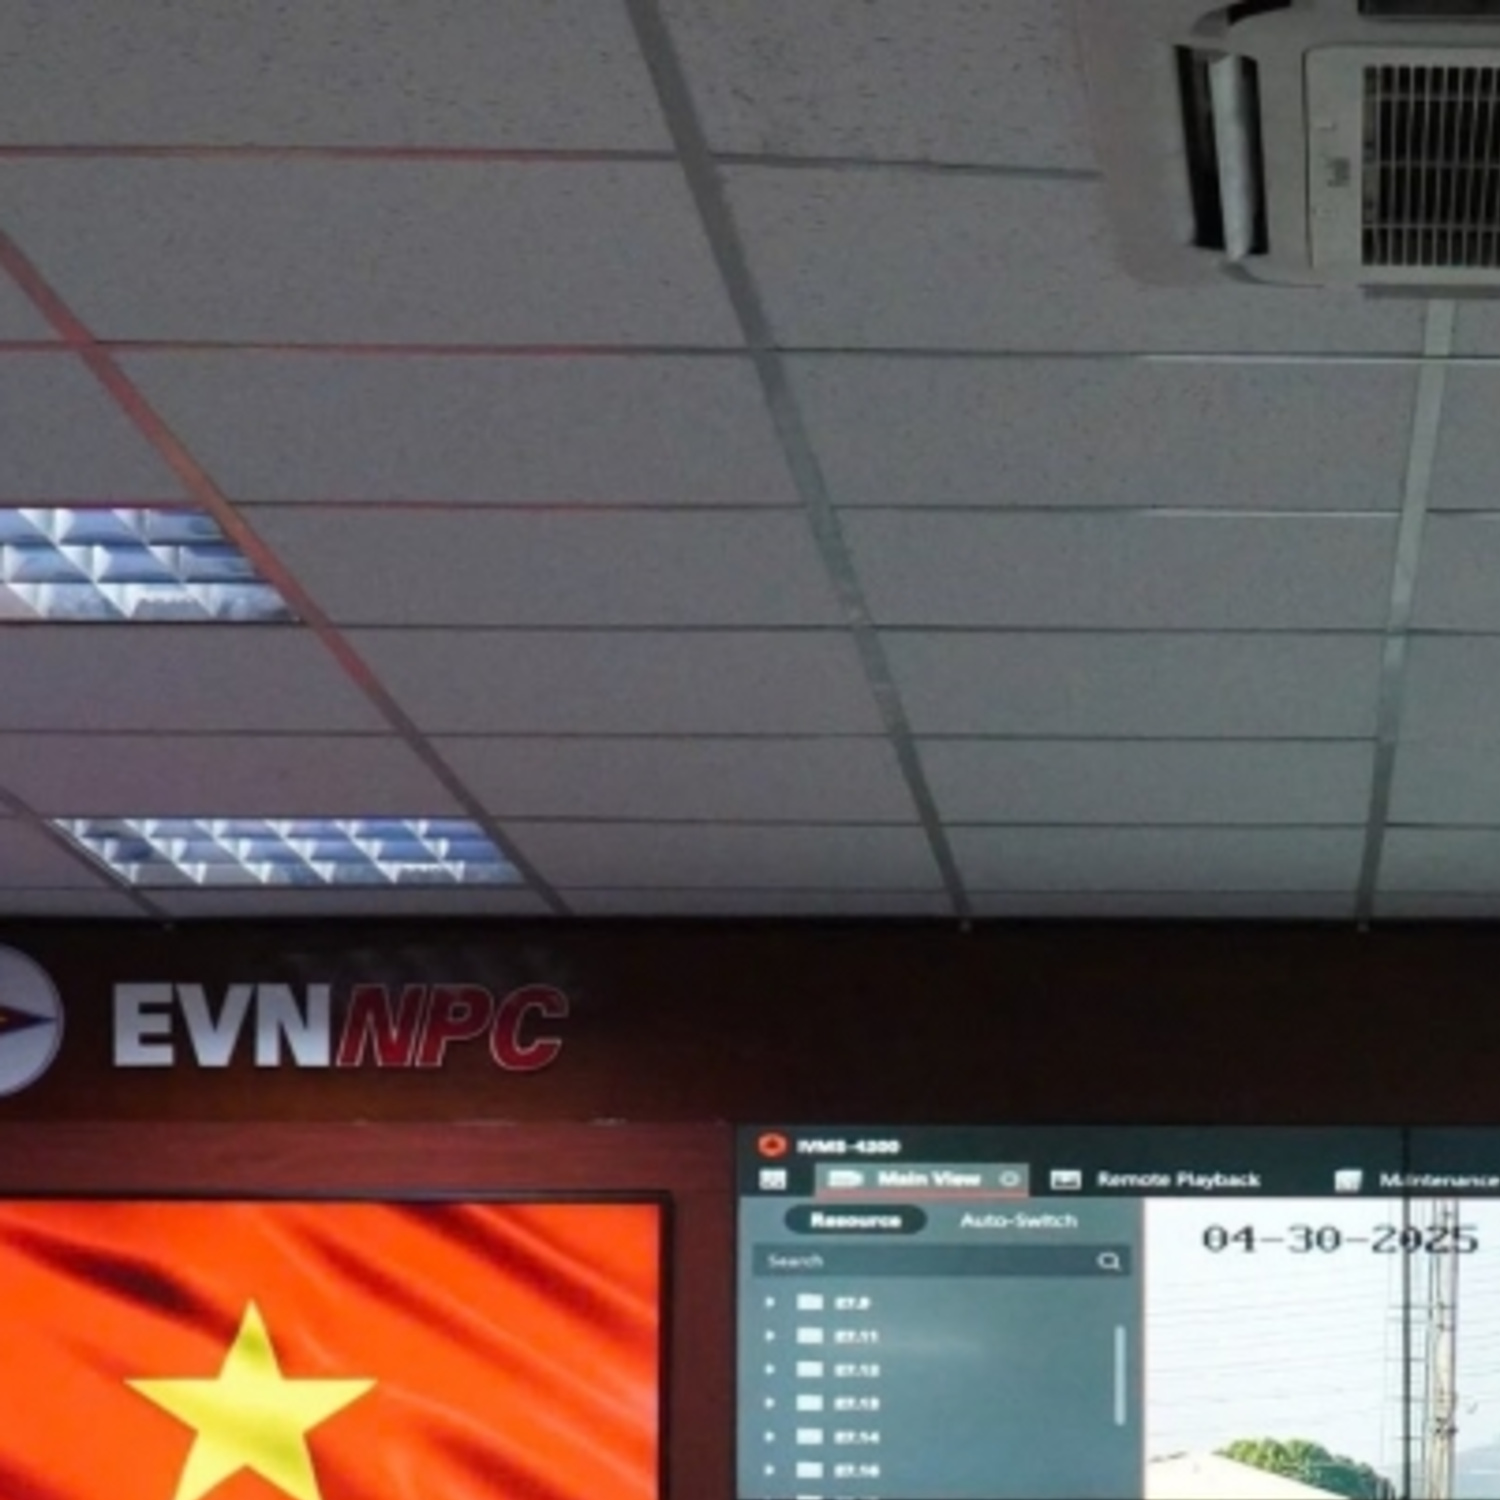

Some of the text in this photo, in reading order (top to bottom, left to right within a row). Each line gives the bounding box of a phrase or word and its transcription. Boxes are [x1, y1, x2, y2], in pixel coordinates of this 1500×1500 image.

[878, 1170, 982, 1187] Main View
[1097, 1169, 1261, 1189] Remote Playback
[1380, 1173, 1500, 1187] Maintenance
[811, 1211, 902, 1228] Resource
[960, 1211, 1079, 1229] Auto-Switch
[1202, 1225, 1479, 1254] 04-30-2025
[767, 1253, 824, 1269] Search
